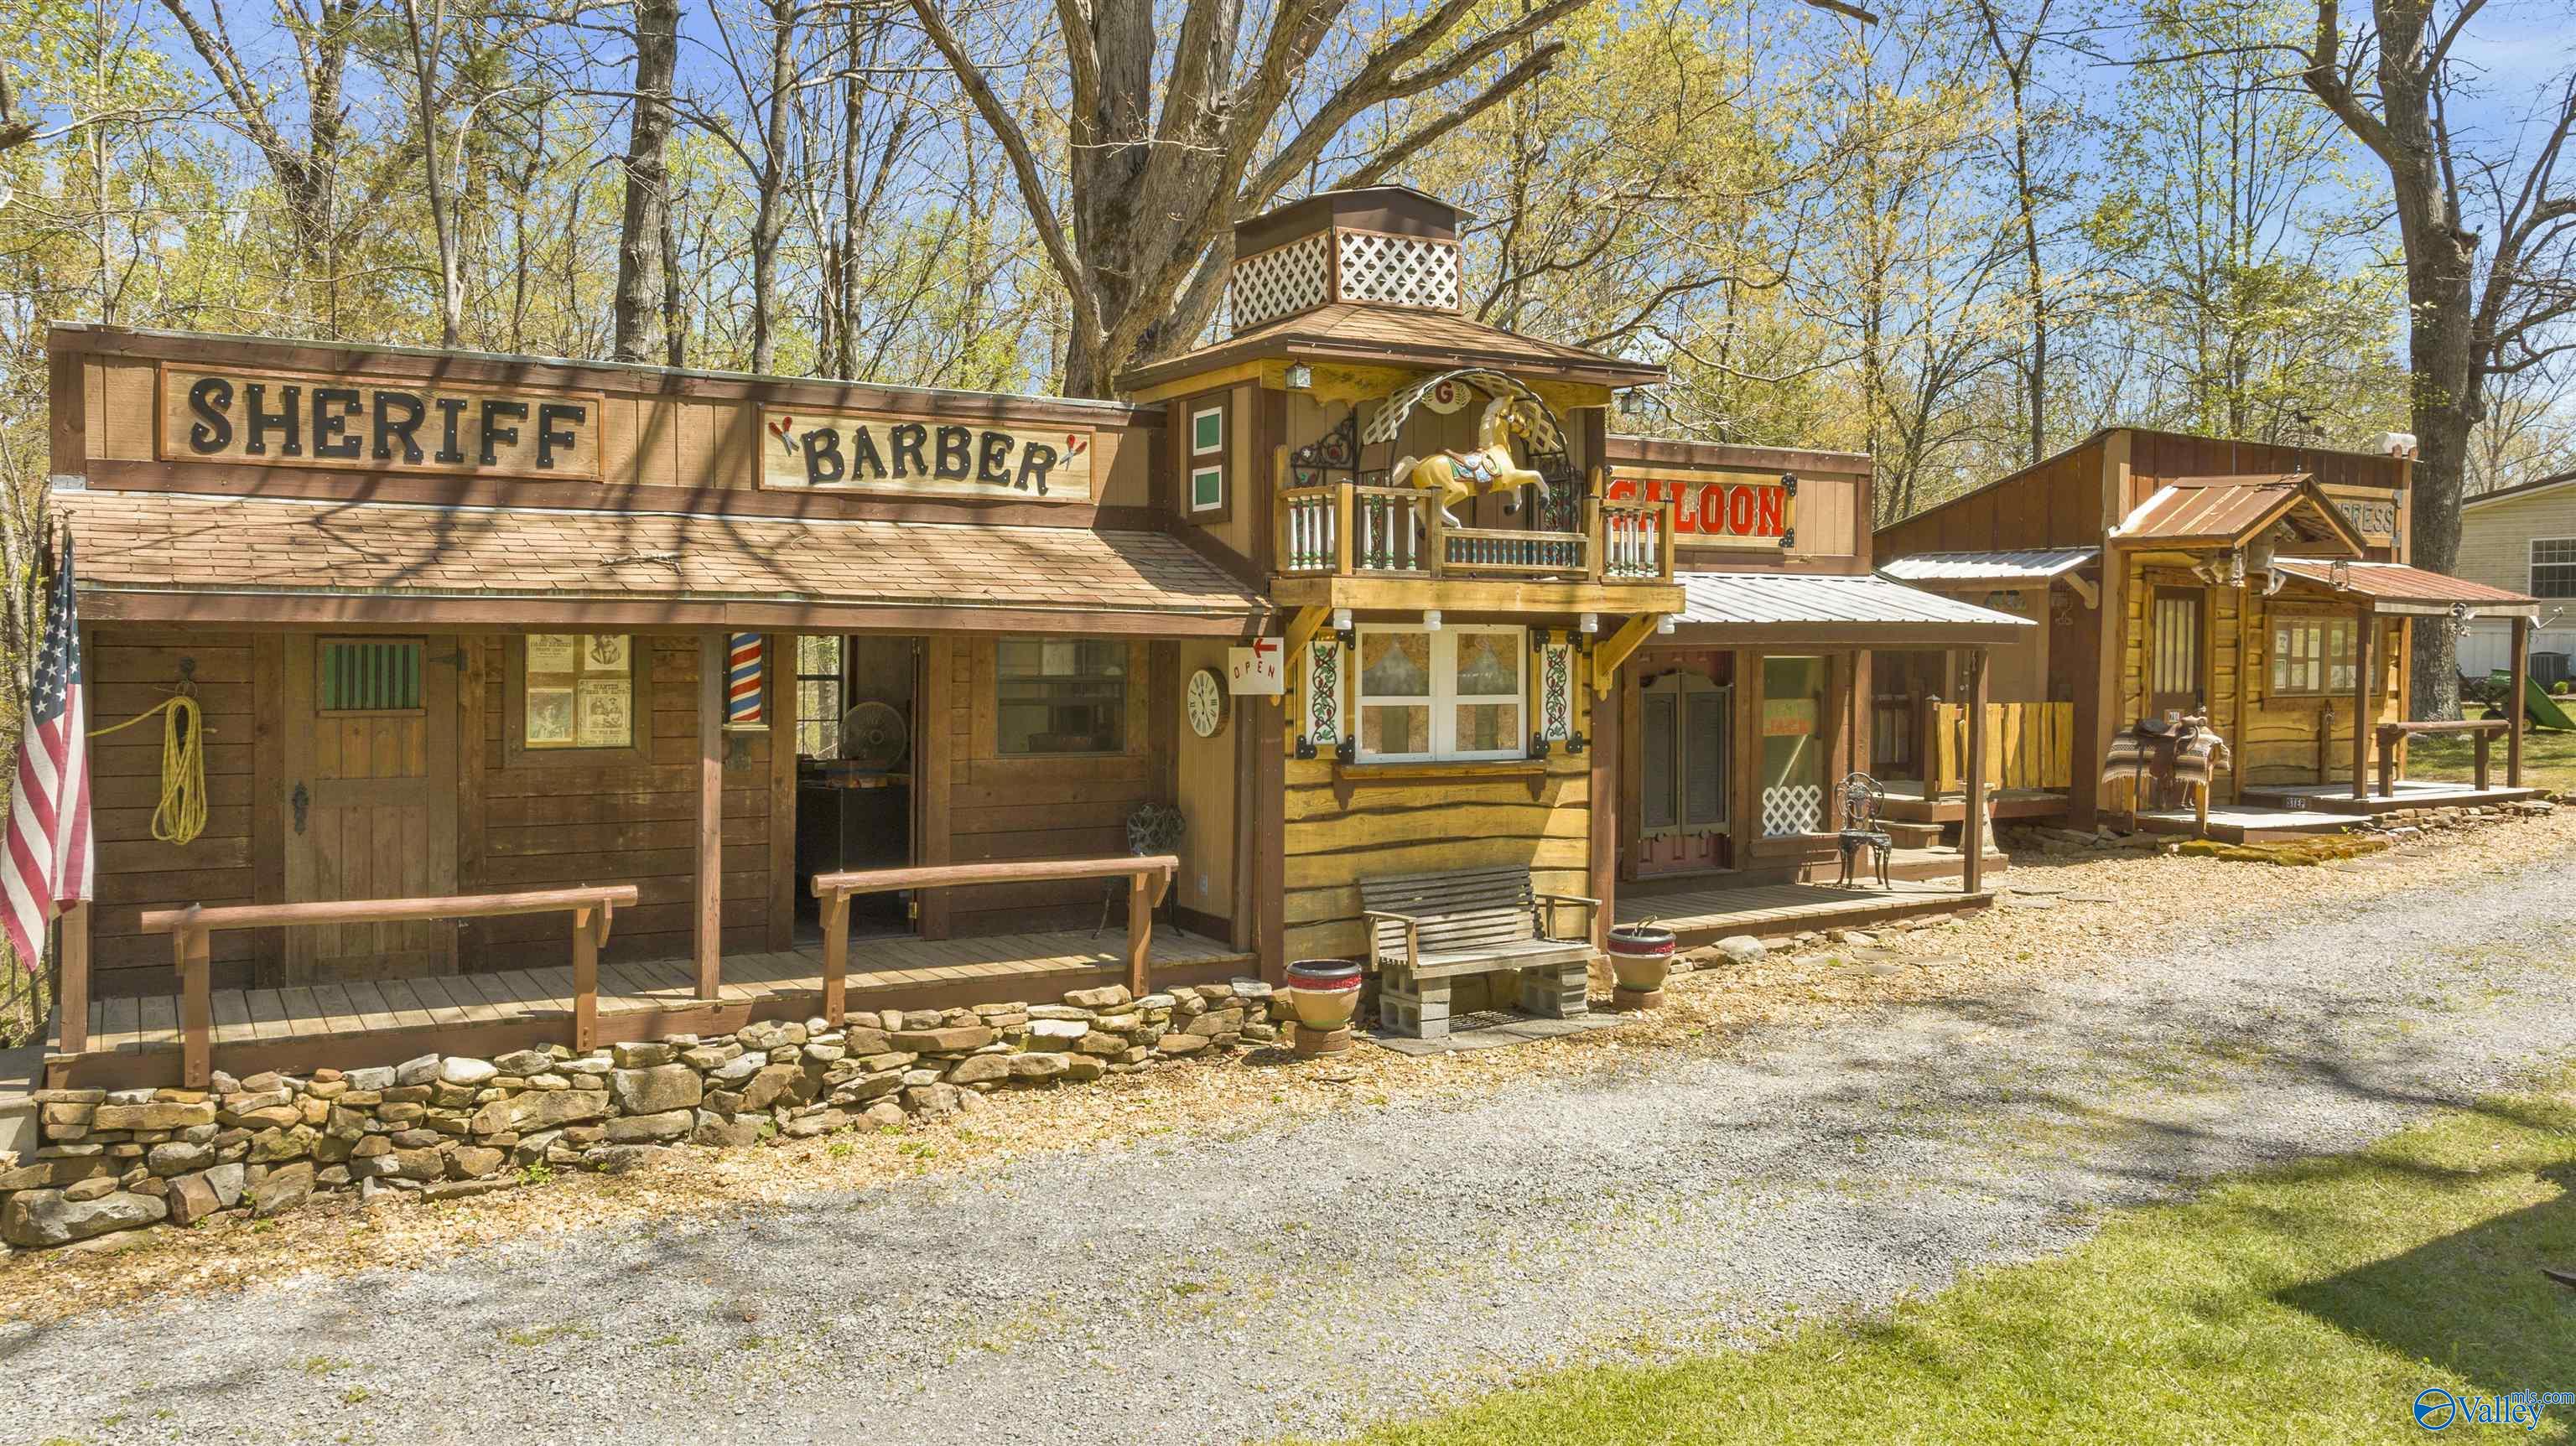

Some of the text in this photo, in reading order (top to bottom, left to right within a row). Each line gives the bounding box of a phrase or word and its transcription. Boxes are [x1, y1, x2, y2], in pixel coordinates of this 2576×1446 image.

[1435, 379, 1454, 404] G
[189, 377, 586, 469] SHERIFF
[800, 423, 1058, 496] BARBER
[1233, 661, 1275, 679] OPEN
